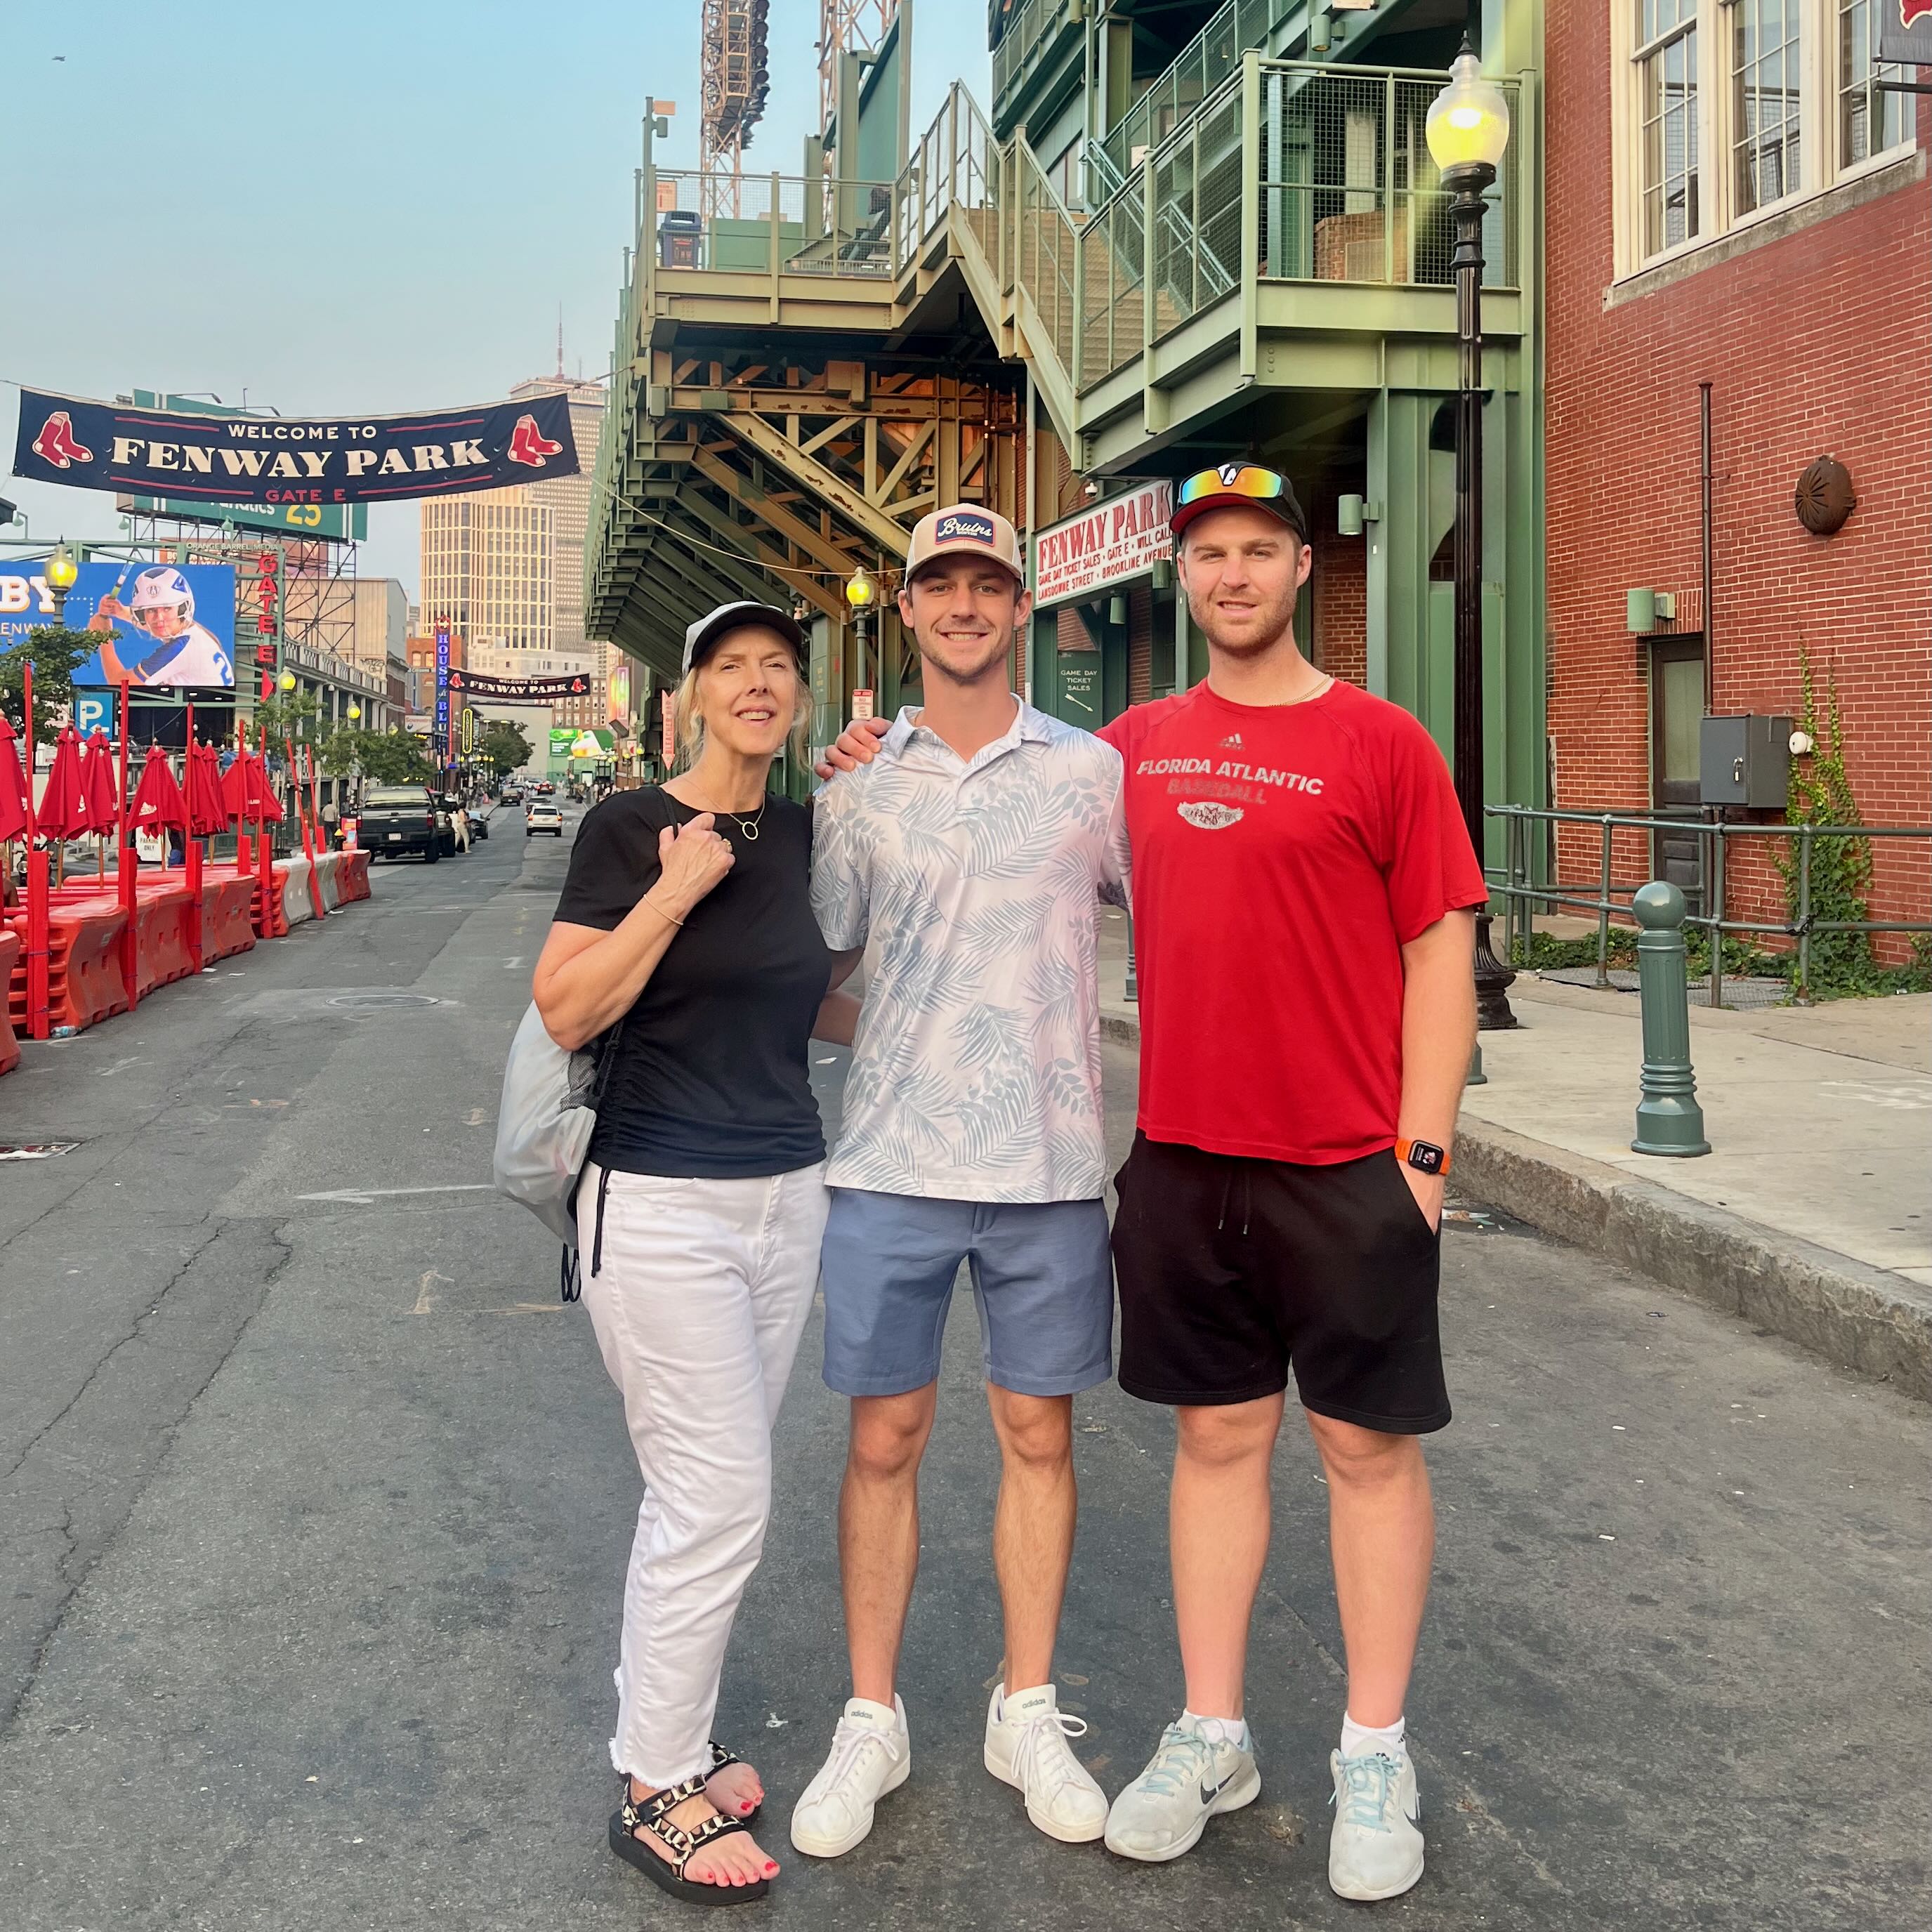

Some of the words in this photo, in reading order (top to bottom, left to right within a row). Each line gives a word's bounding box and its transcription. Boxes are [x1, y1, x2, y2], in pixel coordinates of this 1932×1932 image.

[228, 424, 339, 440] WELCOME
[348, 425, 377, 440] TO
[111, 437, 333, 478] FENWAY
[345, 438, 490, 476] PARK
[265, 489, 322, 503] GATE
[334, 488, 346, 502] E
[938, 518, 992, 537] Bruins
[1038, 511, 1108, 572] FENWAY
[1112, 482, 1172, 544] PARK
[186, 542, 218, 551] ORANGE
[1038, 572, 1052, 586] GAME
[1053, 567, 1063, 579] DAY
[1064, 560, 1082, 576] TICKET
[1083, 553, 1100, 569] SALES
[1108, 544, 1123, 560] GATE
[1124, 541, 1129, 555] E
[1137, 537, 1153, 550] WILL
[1038, 580, 1070, 600] LANSDOWNE
[1072, 571, 1094, 589] STREET
[1102, 555, 1141, 579] BROOKLINE
[1143, 544, 1172, 565] AVENUE
[258, 555, 278, 635] GATE
[258, 644, 276, 663] E
[438, 634, 448, 687] HOUSE
[469, 680, 526, 695] FENWAY
[529, 683, 567, 694] PARK
[79, 699, 103, 730] P
[1136, 758, 1211, 775] FLORIDA
[1216, 761, 1325, 795] ATLANTIC
[1167, 778, 1267, 805] BASEBALL
[850, 1711, 874, 1720] adidas
[1022, 1698, 1046, 1709] adidas
